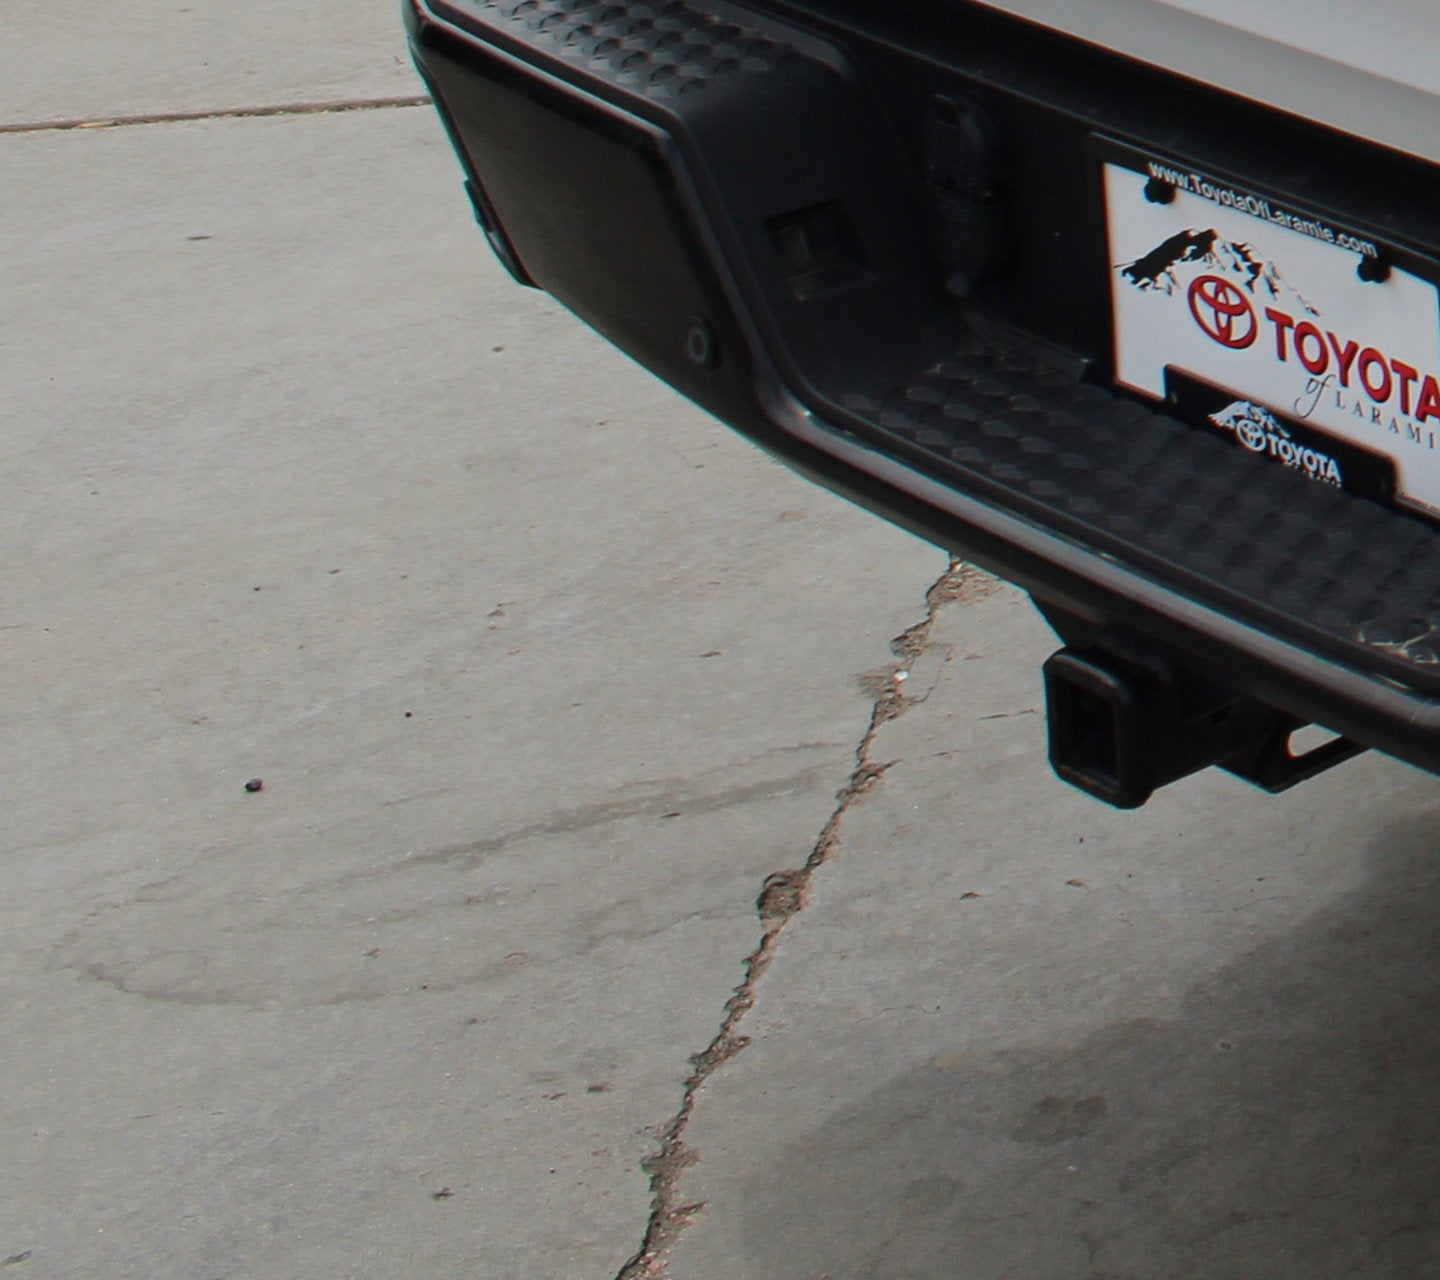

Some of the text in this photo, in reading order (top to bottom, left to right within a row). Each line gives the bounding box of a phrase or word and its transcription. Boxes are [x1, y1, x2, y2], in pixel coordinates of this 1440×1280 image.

[1148, 160, 1378, 258] www.ToyotaOfLaramie.com
[1294, 374, 1336, 419] of
[1266, 432, 1342, 483] TOYOTA
